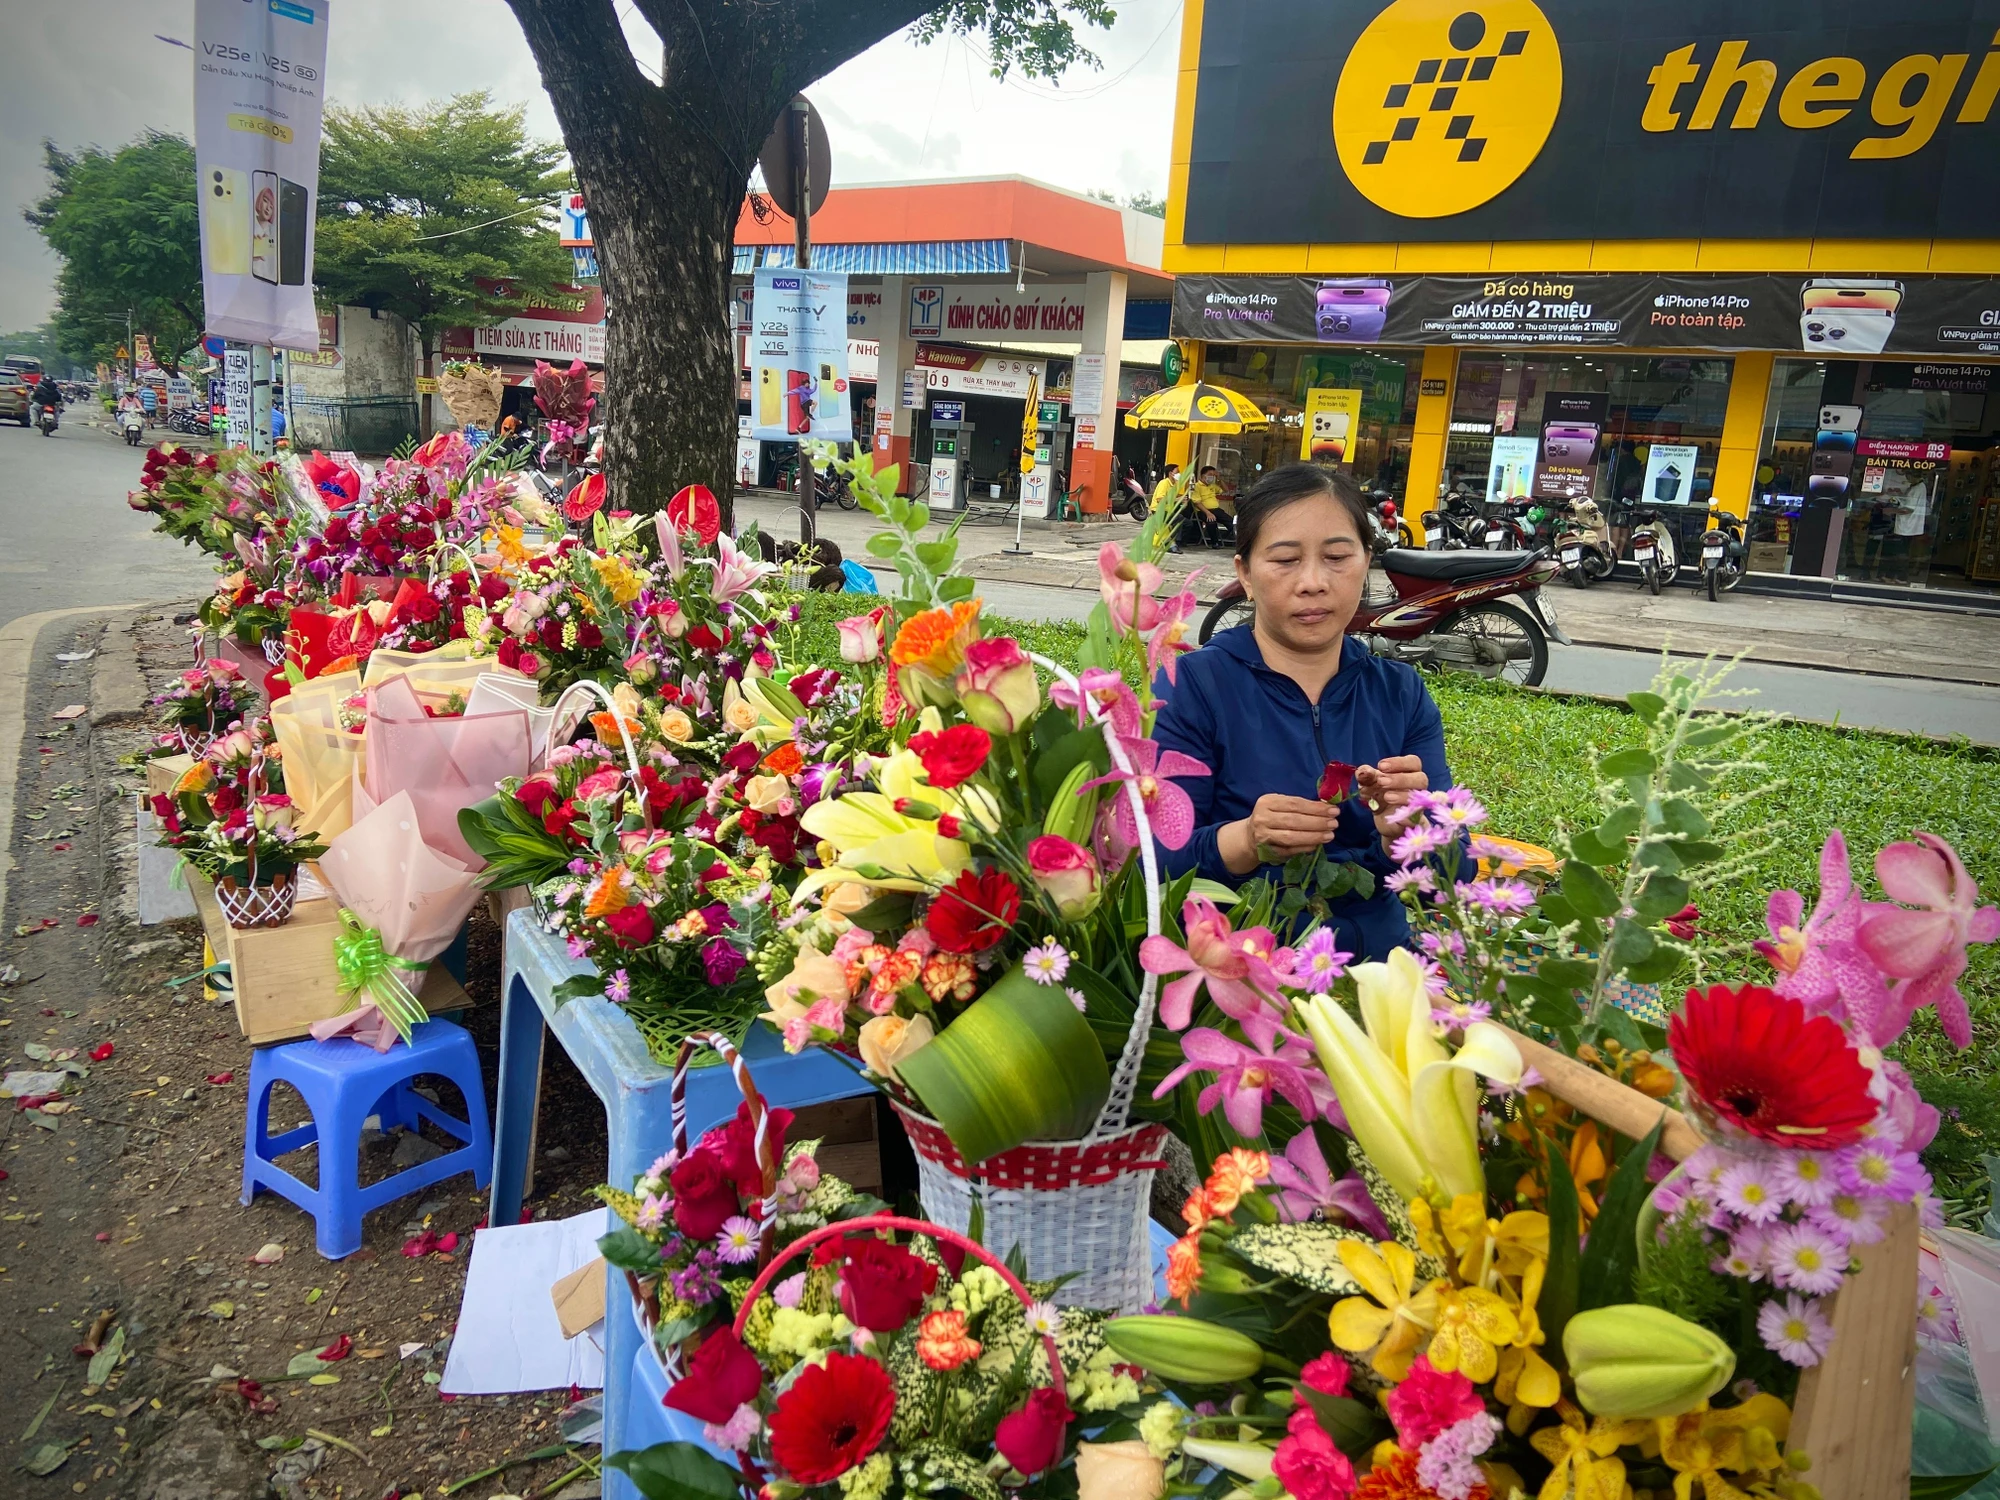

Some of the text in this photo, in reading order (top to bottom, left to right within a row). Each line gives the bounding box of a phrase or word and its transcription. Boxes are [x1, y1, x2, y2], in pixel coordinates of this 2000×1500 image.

[202, 41, 251, 62] V25e
[262, 52, 290, 74] V25
[775, 280, 798, 288] vivo
[918, 290, 936, 302] MP
[1483, 281, 1574, 300] Đã có hàng
[1214, 294, 1278, 306] iPhone 14 Pro
[1664, 294, 1750, 309] iPhone 14 Pro
[776, 306, 812, 314] THAT'S
[947, 296, 1084, 331] KÍNH CHÀO QUÝ KHÁCH
[1204, 308, 1276, 324] Pro. Vượt trội.
[1452, 299, 1592, 326] GIẢM ĐẾN 2 TRIỆU
[859, 316, 866, 324] 9
[1650, 312, 1746, 330] Pro toàn tập.
[760, 322, 789, 331] Y22s
[1424, 322, 1444, 331] VNPay
[1445, 322, 1462, 332] giảm
[1479, 322, 1514, 331] 300.000
[1524, 323, 1538, 332] Thu
[1584, 322, 1590, 332] 2
[1590, 322, 1618, 336] TRIỆU
[505, 324, 526, 349] SỬA
[528, 331, 542, 349] XE
[544, 325, 582, 354] THẮNG
[1942, 330, 1992, 342] VNPay giảm
[764, 341, 785, 350] Y16
[1978, 342, 1999, 352] Giảm
[316, 350, 333, 365] XE
[928, 350, 966, 366] Havoline
[1922, 365, 1991, 378] iPhone 14 Pro
[942, 375, 949, 388] 9
[986, 378, 1001, 388] THAY
[1911, 378, 1932, 390] Pro.
[1450, 422, 1492, 433] SAMSUNG
[1868, 441, 1919, 453] ĐIỂM NẠP/RÚT
[1866, 457, 1936, 471] BÁN TRẢ GÓP
[1567, 466, 1583, 476] hàng
[1567, 474, 1572, 482] 2
